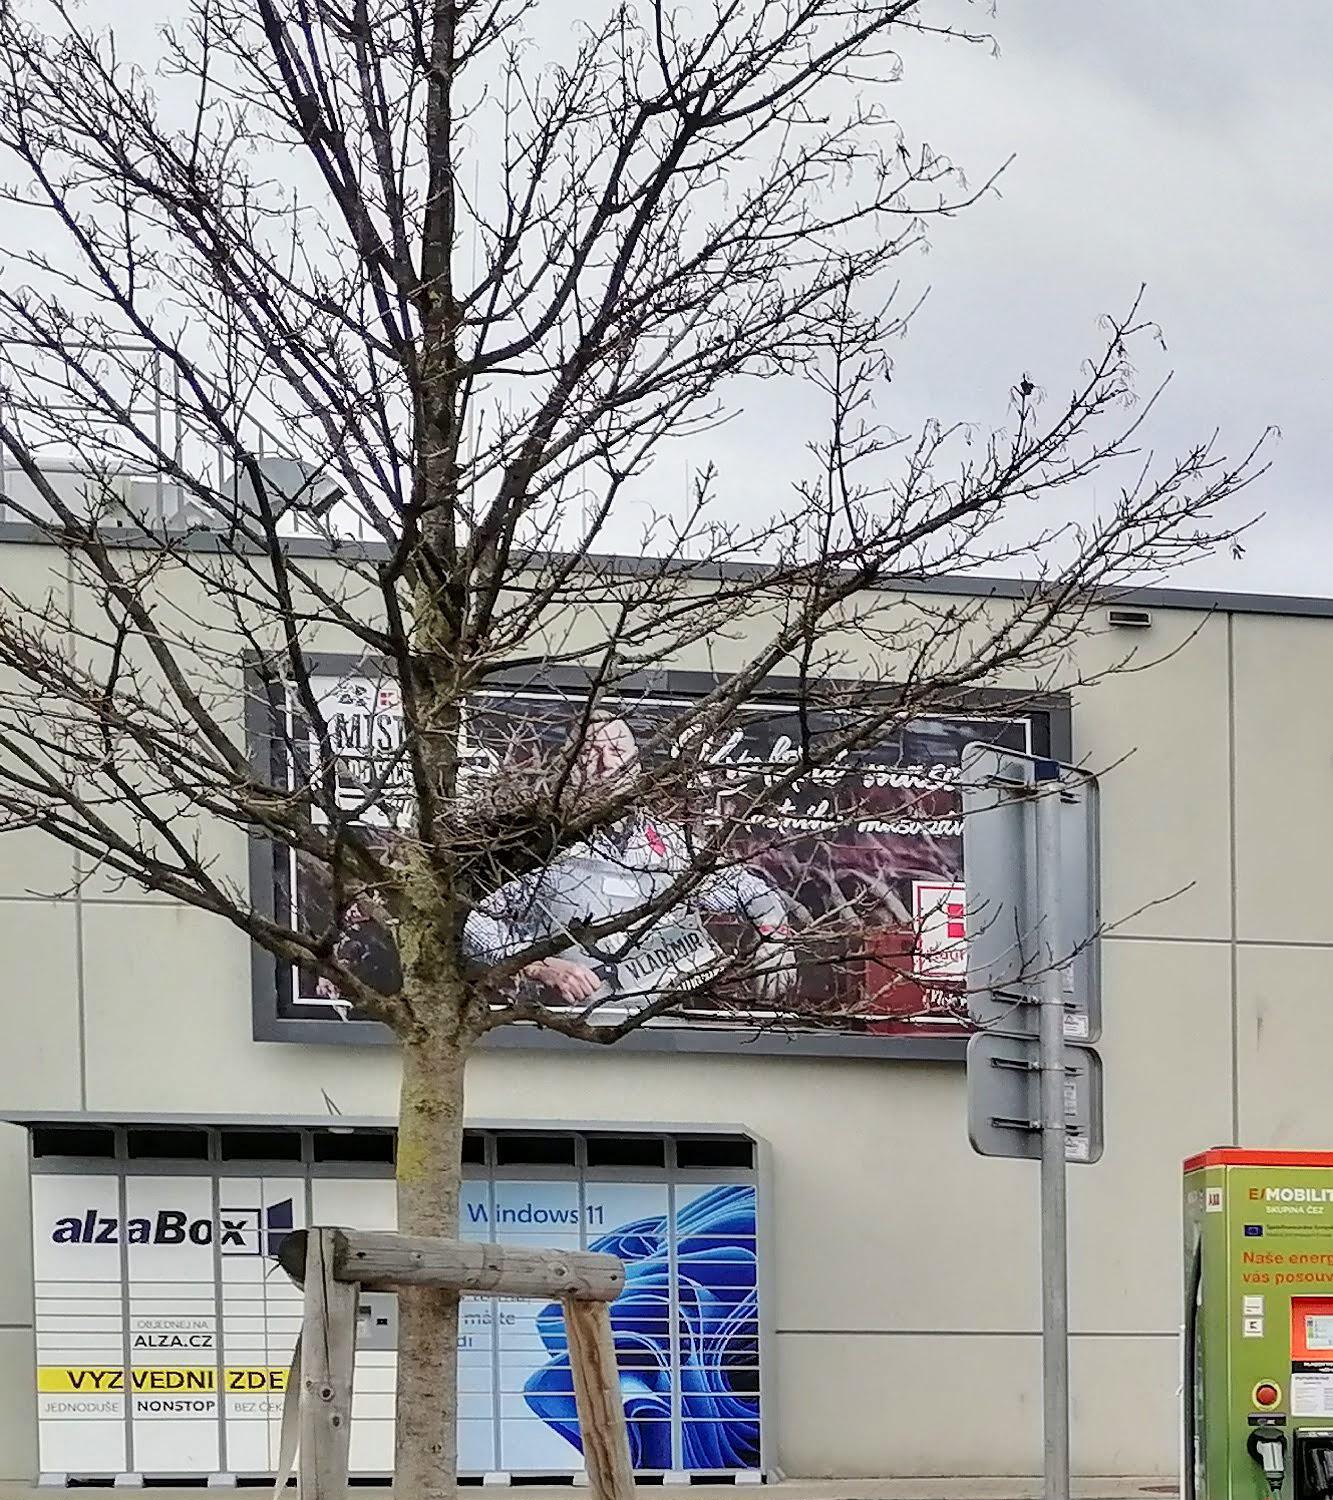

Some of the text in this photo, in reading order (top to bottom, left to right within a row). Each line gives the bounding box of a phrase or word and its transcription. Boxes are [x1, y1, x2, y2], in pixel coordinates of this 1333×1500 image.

[467, 1203, 579, 1225] Windows
[52, 1209, 247, 1246] alzaBox
[1242, 1251, 1285, 1265] Naše
[134, 1334, 213, 1348] ALZA.CZ
[228, 1370, 285, 1390] ZDE
[137, 1400, 216, 1413] NONSTOP
